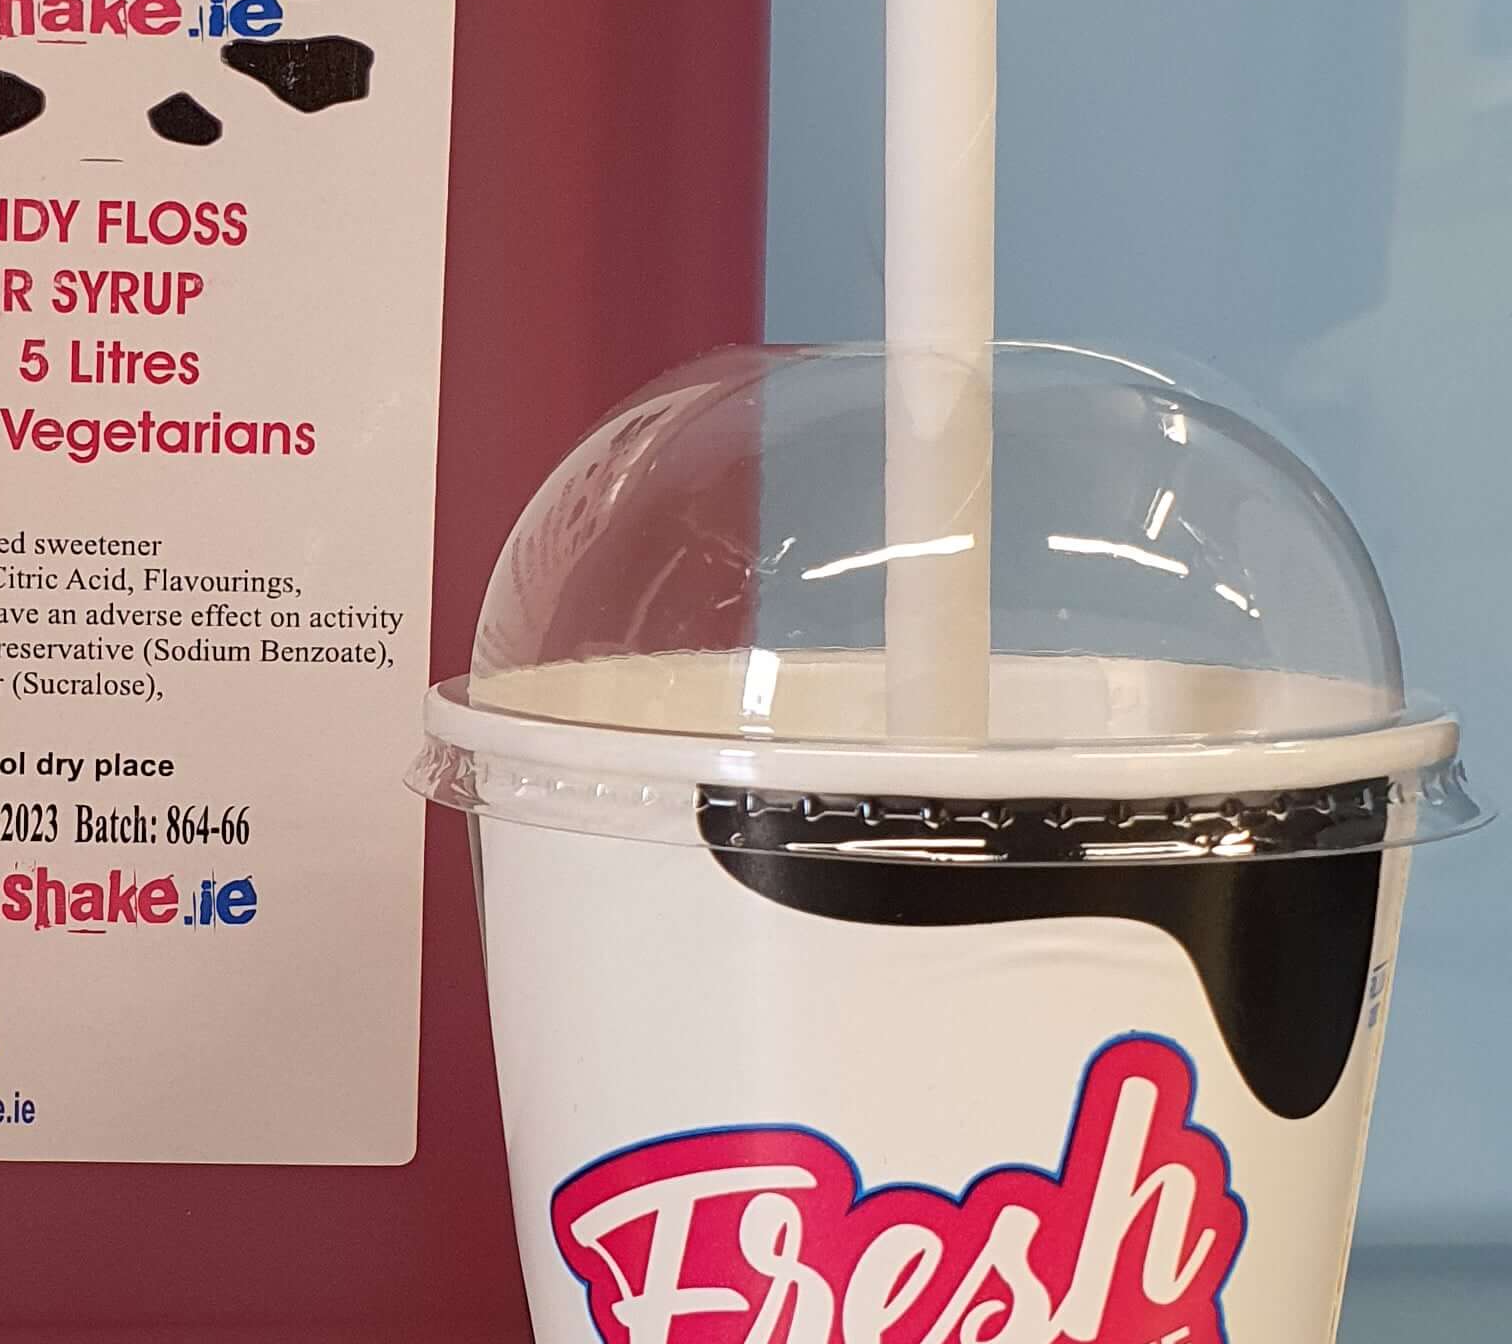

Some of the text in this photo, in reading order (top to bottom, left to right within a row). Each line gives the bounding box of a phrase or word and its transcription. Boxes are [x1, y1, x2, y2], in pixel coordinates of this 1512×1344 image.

[98, 200, 248, 247] FLOSS
[51, 269, 204, 316] SYRUP
[19, 338, 49, 383] 5
[70, 339, 200, 385] Litres
[0, 407, 316, 464] Vegetarians
[34, 536, 163, 557] sweetener
[65, 567, 134, 596] Acid,
[143, 567, 302, 600] Flavourings,
[48, 608, 76, 625] an
[85, 602, 182, 627] adverse
[191, 603, 262, 628] effect
[270, 611, 300, 628] on
[309, 605, 404, 635] activity
[143, 638, 250, 667] (Sodium
[260, 639, 394, 670] Benzoate),
[12, 671, 163, 703] (Sucralose),
[36, 751, 85, 783] dry
[95, 752, 175, 782] place
[74, 804, 157, 844] Batch:
[166, 804, 250, 845] 864-66
